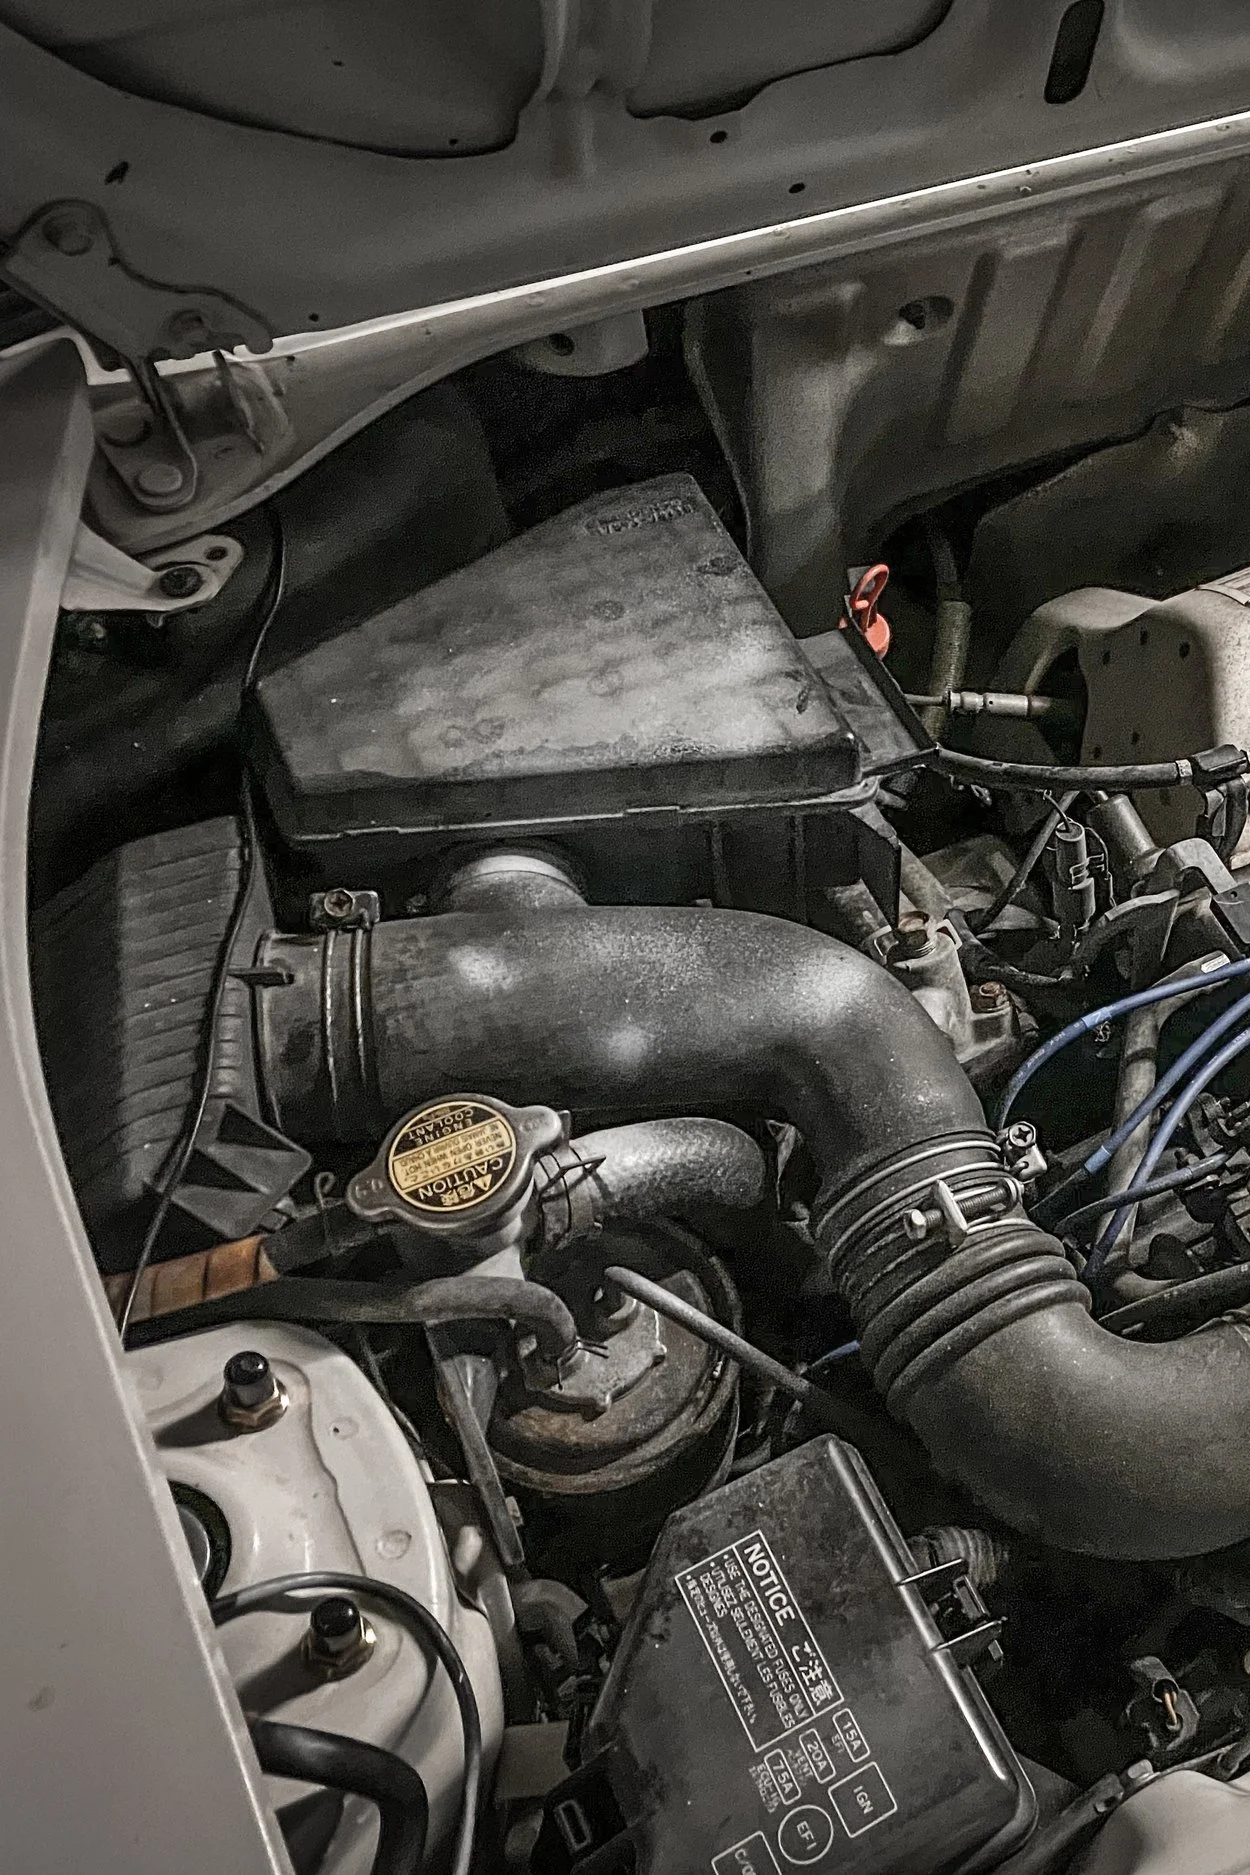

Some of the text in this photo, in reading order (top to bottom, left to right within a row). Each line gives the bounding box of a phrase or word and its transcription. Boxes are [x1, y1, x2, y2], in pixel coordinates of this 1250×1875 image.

[408, 1109, 473, 1140] COOLANT
[414, 1116, 472, 1145] ENGINE
[475, 1132, 502, 1146] NEVER
[423, 1153, 448, 1167] WHEN
[450, 1142, 472, 1156] OPEN
[417, 1157, 503, 1200] CAUTION
[724, 1558, 809, 1718] USE THE DESIGNATED FUSES ONLY
[744, 1543, 795, 1626] NOTICE
[792, 1641, 833, 1706] ご注意
[757, 1661, 773, 1683] LES
[767, 1681, 795, 1729] FUSIBLES
[831, 1733, 844, 1753] EFI
[843, 1721, 861, 1750] 15A
[807, 1741, 827, 1771] 20A
[853, 1786, 873, 1814] IGN
[796, 1821, 816, 1849] EFI
